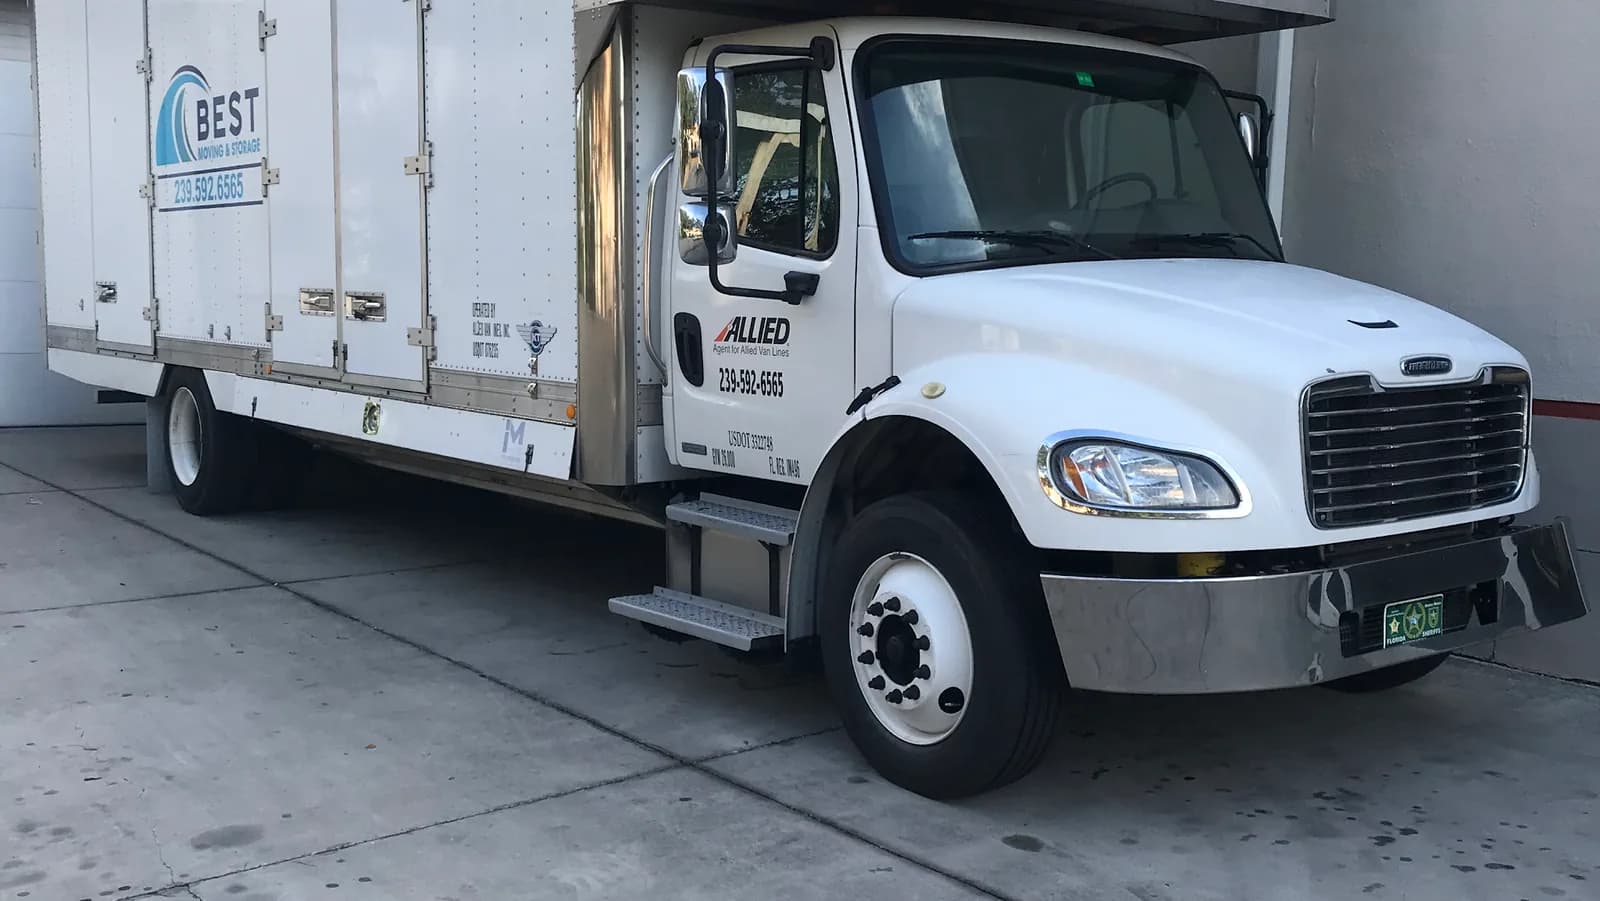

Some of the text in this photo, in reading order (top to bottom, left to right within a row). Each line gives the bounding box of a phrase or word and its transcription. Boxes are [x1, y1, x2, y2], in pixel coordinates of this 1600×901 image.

[196, 87, 259, 141] BEST
[198, 138, 260, 160] MOVING & STORAGE
[174, 172, 244, 203] 239.592.6565
[722, 316, 790, 345] ALLIED
[713, 344, 731, 355] Agent
[741, 345, 757, 355] Allied
[759, 346, 771, 356] Van
[772, 347, 789, 357] Lines
[719, 368, 784, 397] 239-592-6565
[727, 430, 750, 449] USDOT
[1386, 635, 1406, 645] FLORIDA
[1422, 628, 1441, 637] SHERIFFS
